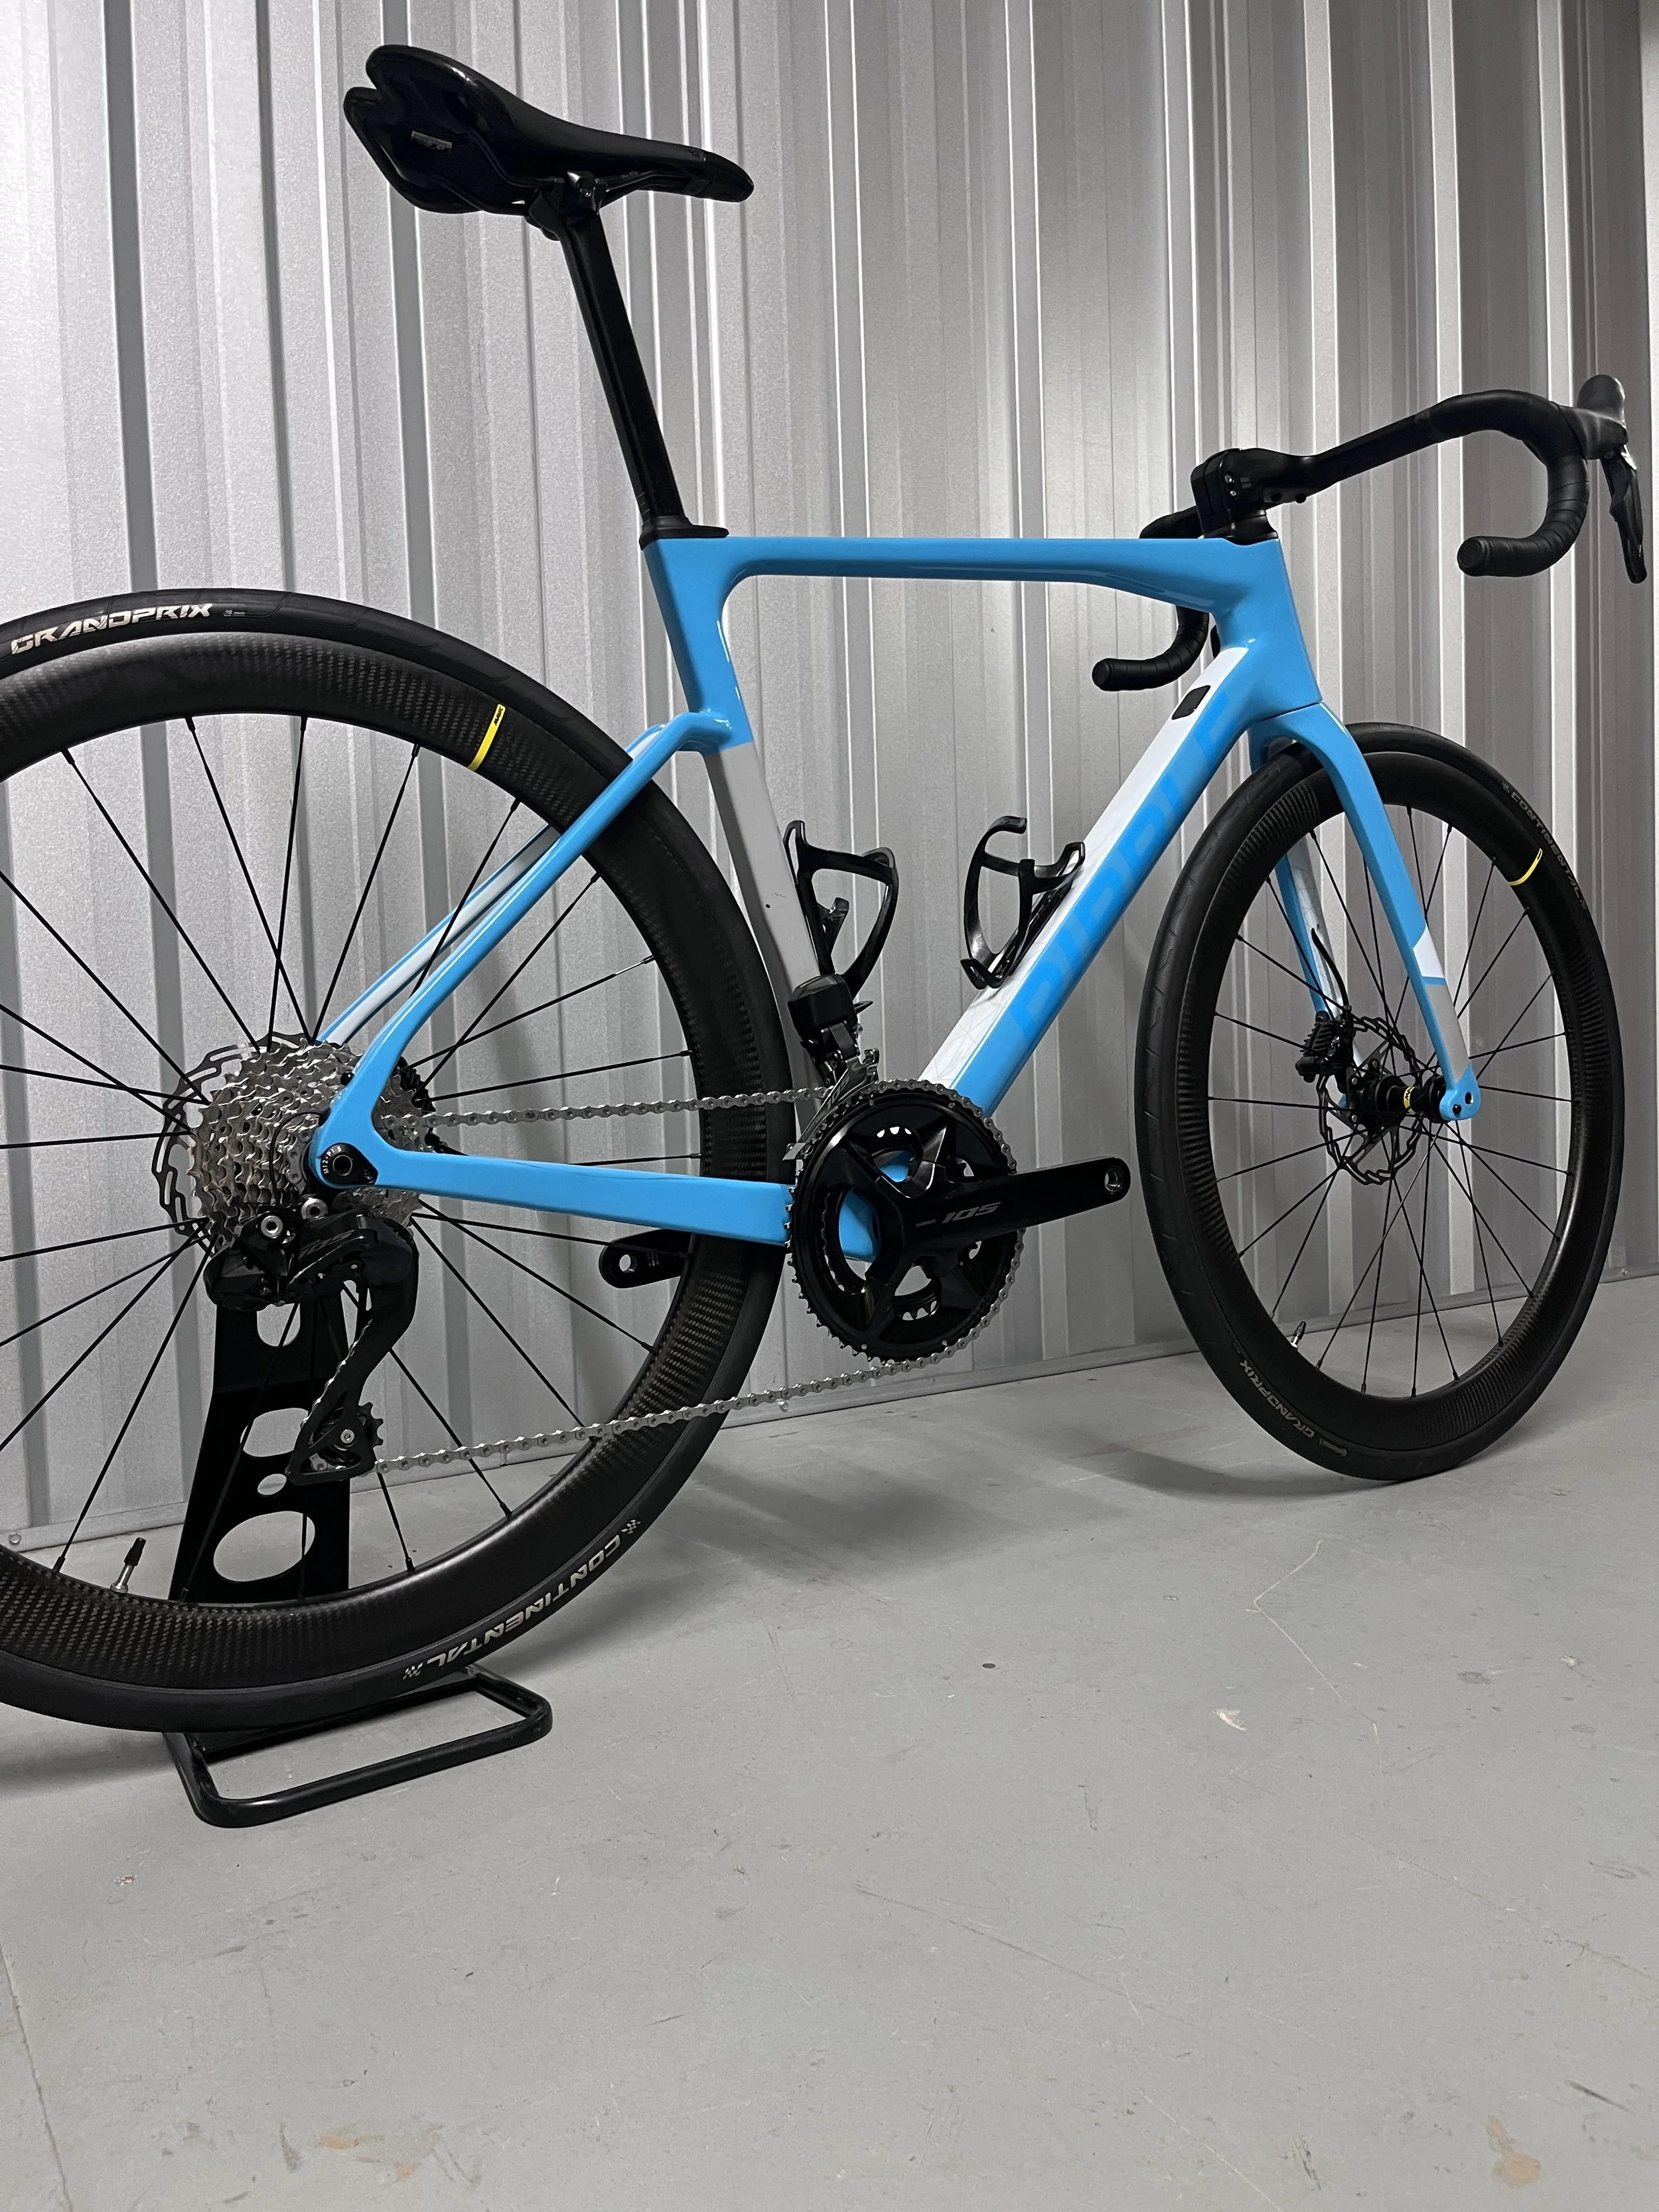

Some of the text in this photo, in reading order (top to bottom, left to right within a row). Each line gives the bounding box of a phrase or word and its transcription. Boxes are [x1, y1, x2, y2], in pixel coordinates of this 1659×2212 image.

[11, 603, 213, 655] GRANDPRIX
[941, 1201, 1001, 1224] 105
[297, 1229, 355, 1261] 105
[427, 1534, 620, 1667] CONTINENTAL
